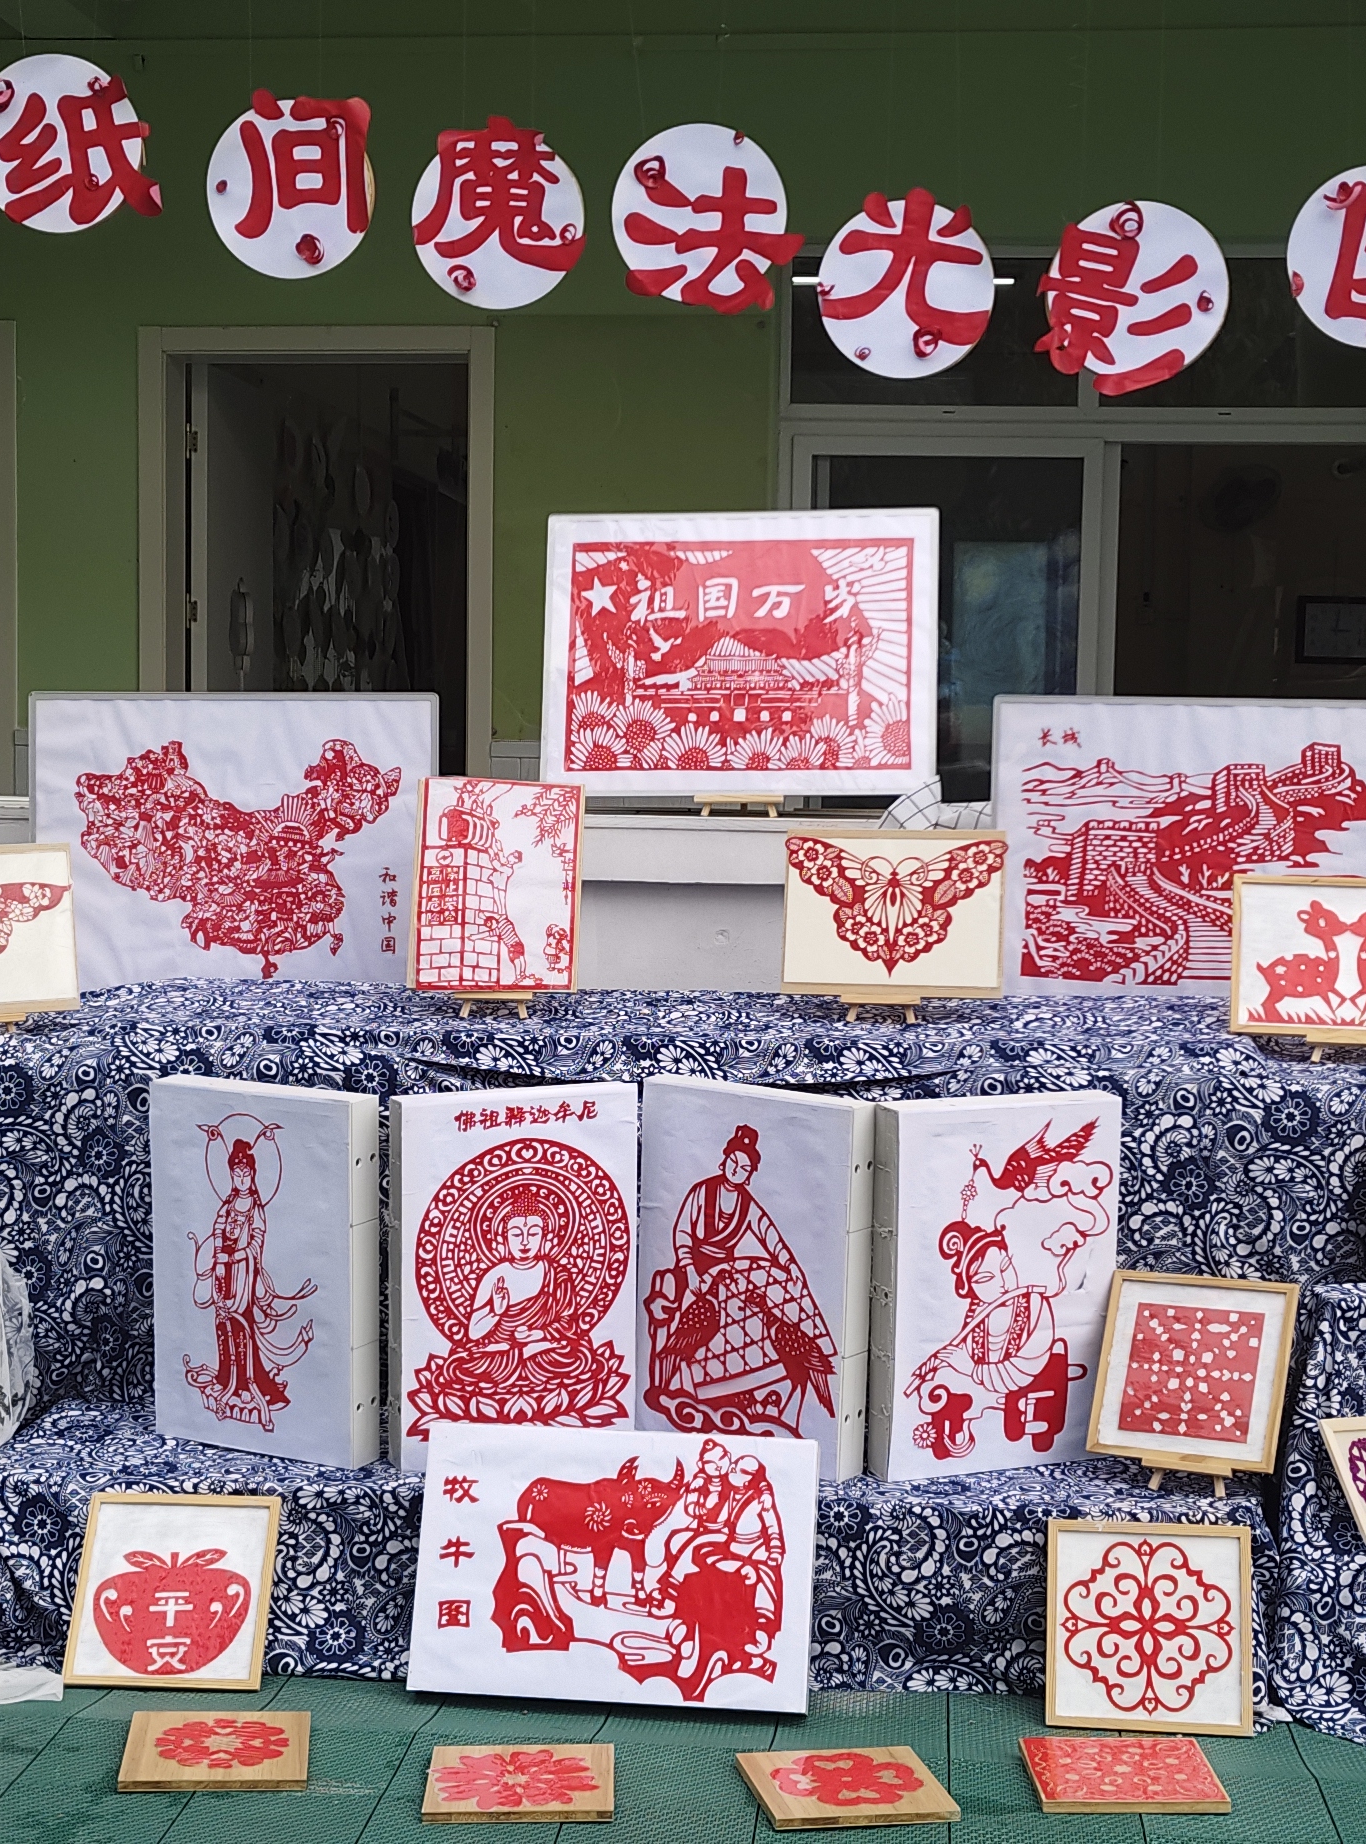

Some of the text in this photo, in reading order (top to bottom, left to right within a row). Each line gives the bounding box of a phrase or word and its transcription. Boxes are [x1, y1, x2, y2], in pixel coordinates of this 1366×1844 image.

[630, 573, 861, 624] 祖国万岁
[1037, 727, 1083, 749] 长城
[378, 866, 399, 955] 和谐中国
[426, 867, 442, 926] 高压危险
[453, 1099, 599, 1133] 佛祖释迦牟尼
[437, 1475, 480, 1630] 牧牛图
[146, 1591, 194, 1673] 平安
